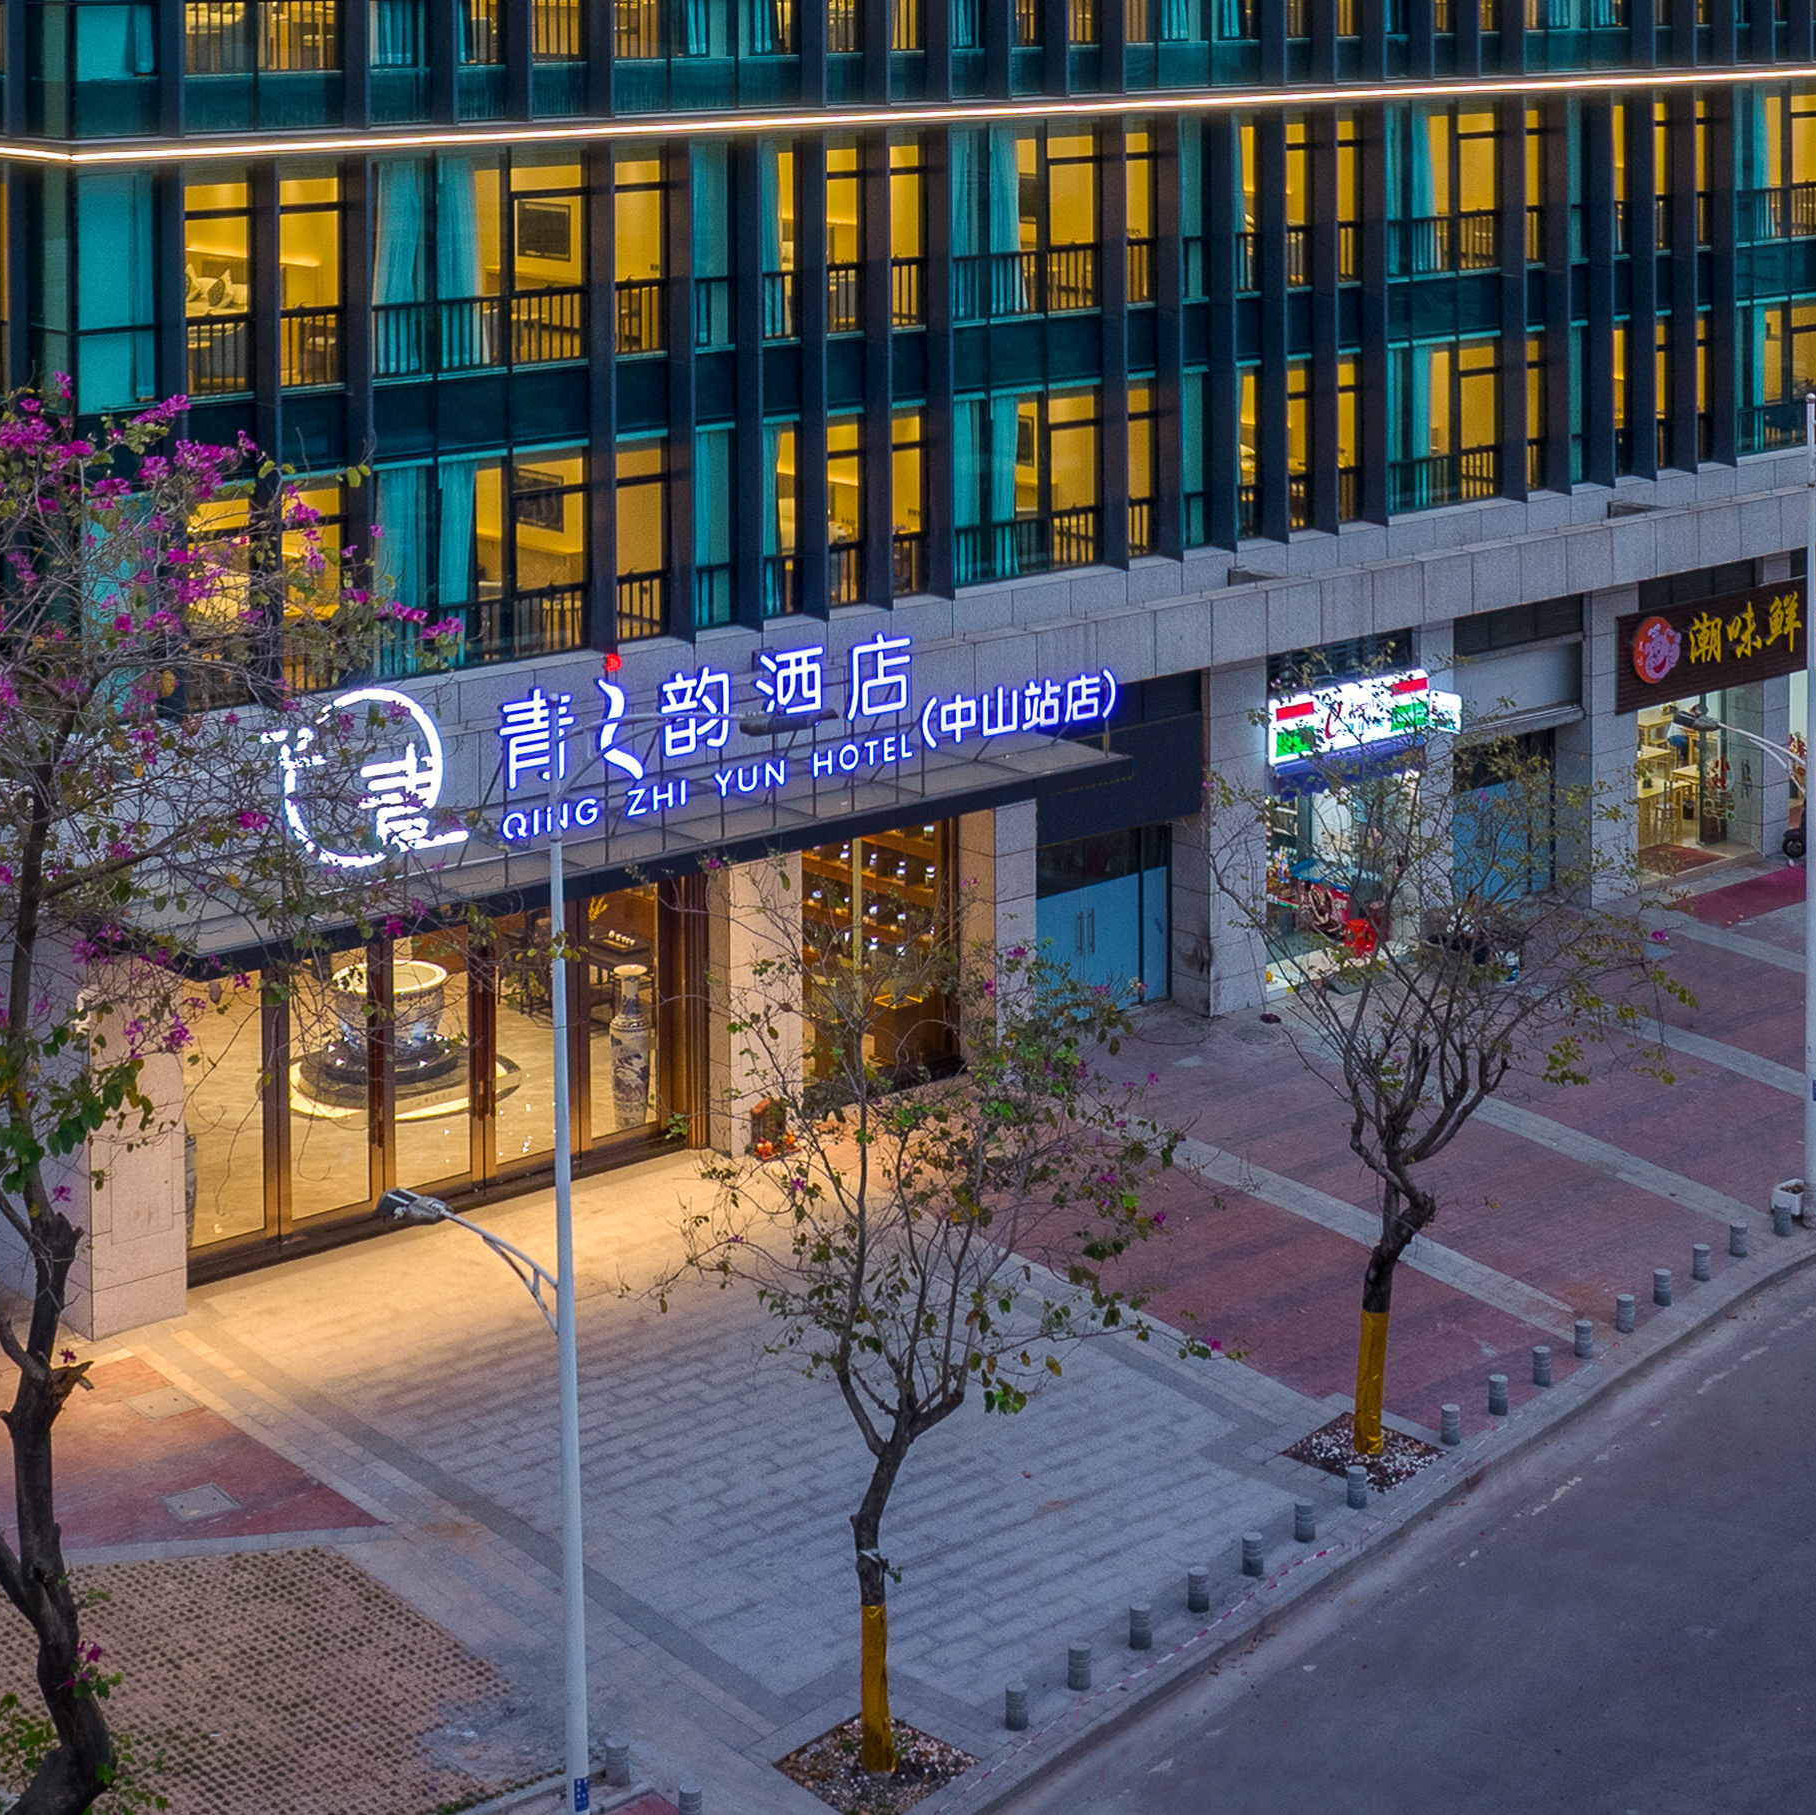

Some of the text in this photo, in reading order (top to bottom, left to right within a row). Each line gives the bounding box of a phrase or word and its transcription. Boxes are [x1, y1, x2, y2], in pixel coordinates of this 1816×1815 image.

[1689, 591, 1802, 664] 潮味鲜
[502, 734, 914, 840] QING ZHI YUN HOTEL
